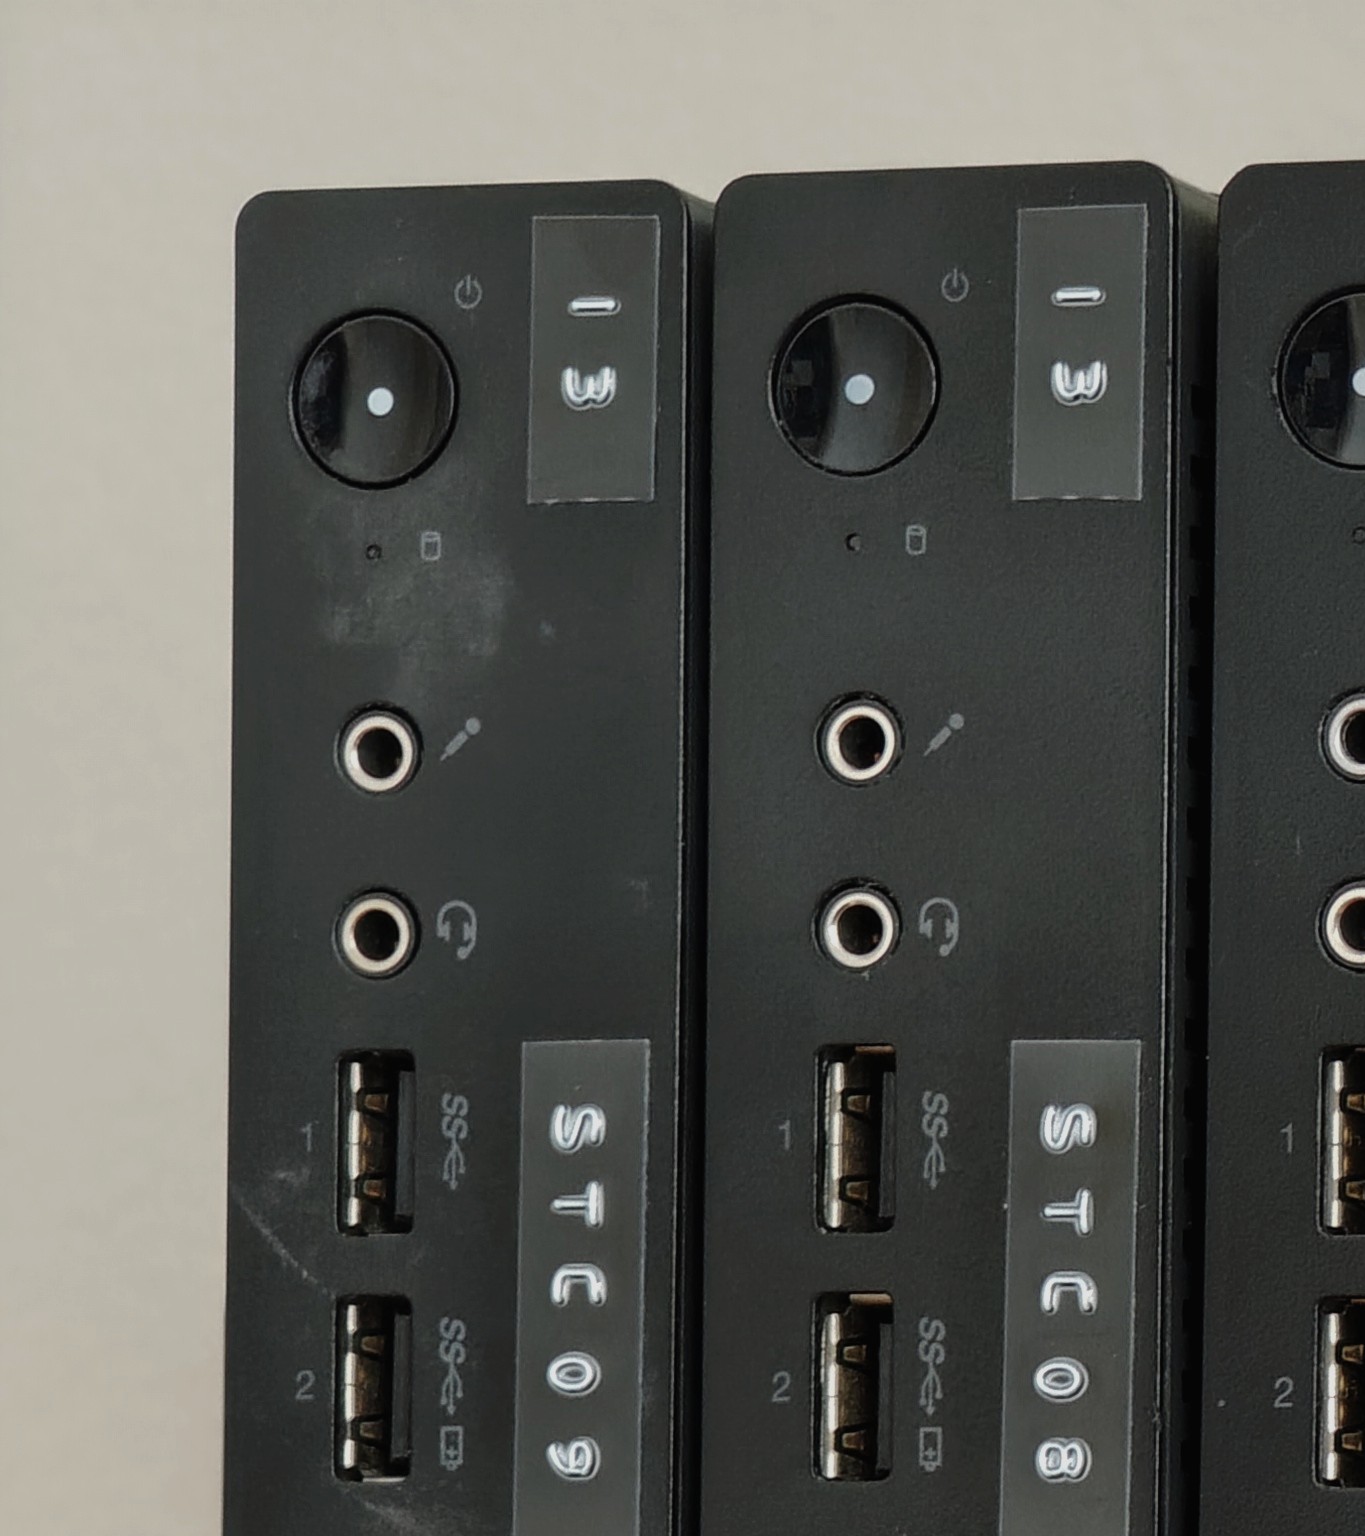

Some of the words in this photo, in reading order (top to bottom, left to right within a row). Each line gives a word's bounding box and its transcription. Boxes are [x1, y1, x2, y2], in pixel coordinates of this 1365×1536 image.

[301, 1124, 315, 1151] 1
[779, 1123, 792, 1149] 1
[1279, 1124, 1295, 1153] 1
[546, 1103, 608, 1482] STC09
[1033, 1103, 1099, 1485] STC08
[294, 1371, 315, 1399] 2
[771, 1371, 791, 1400] 2
[1273, 1377, 1293, 1408] 2
